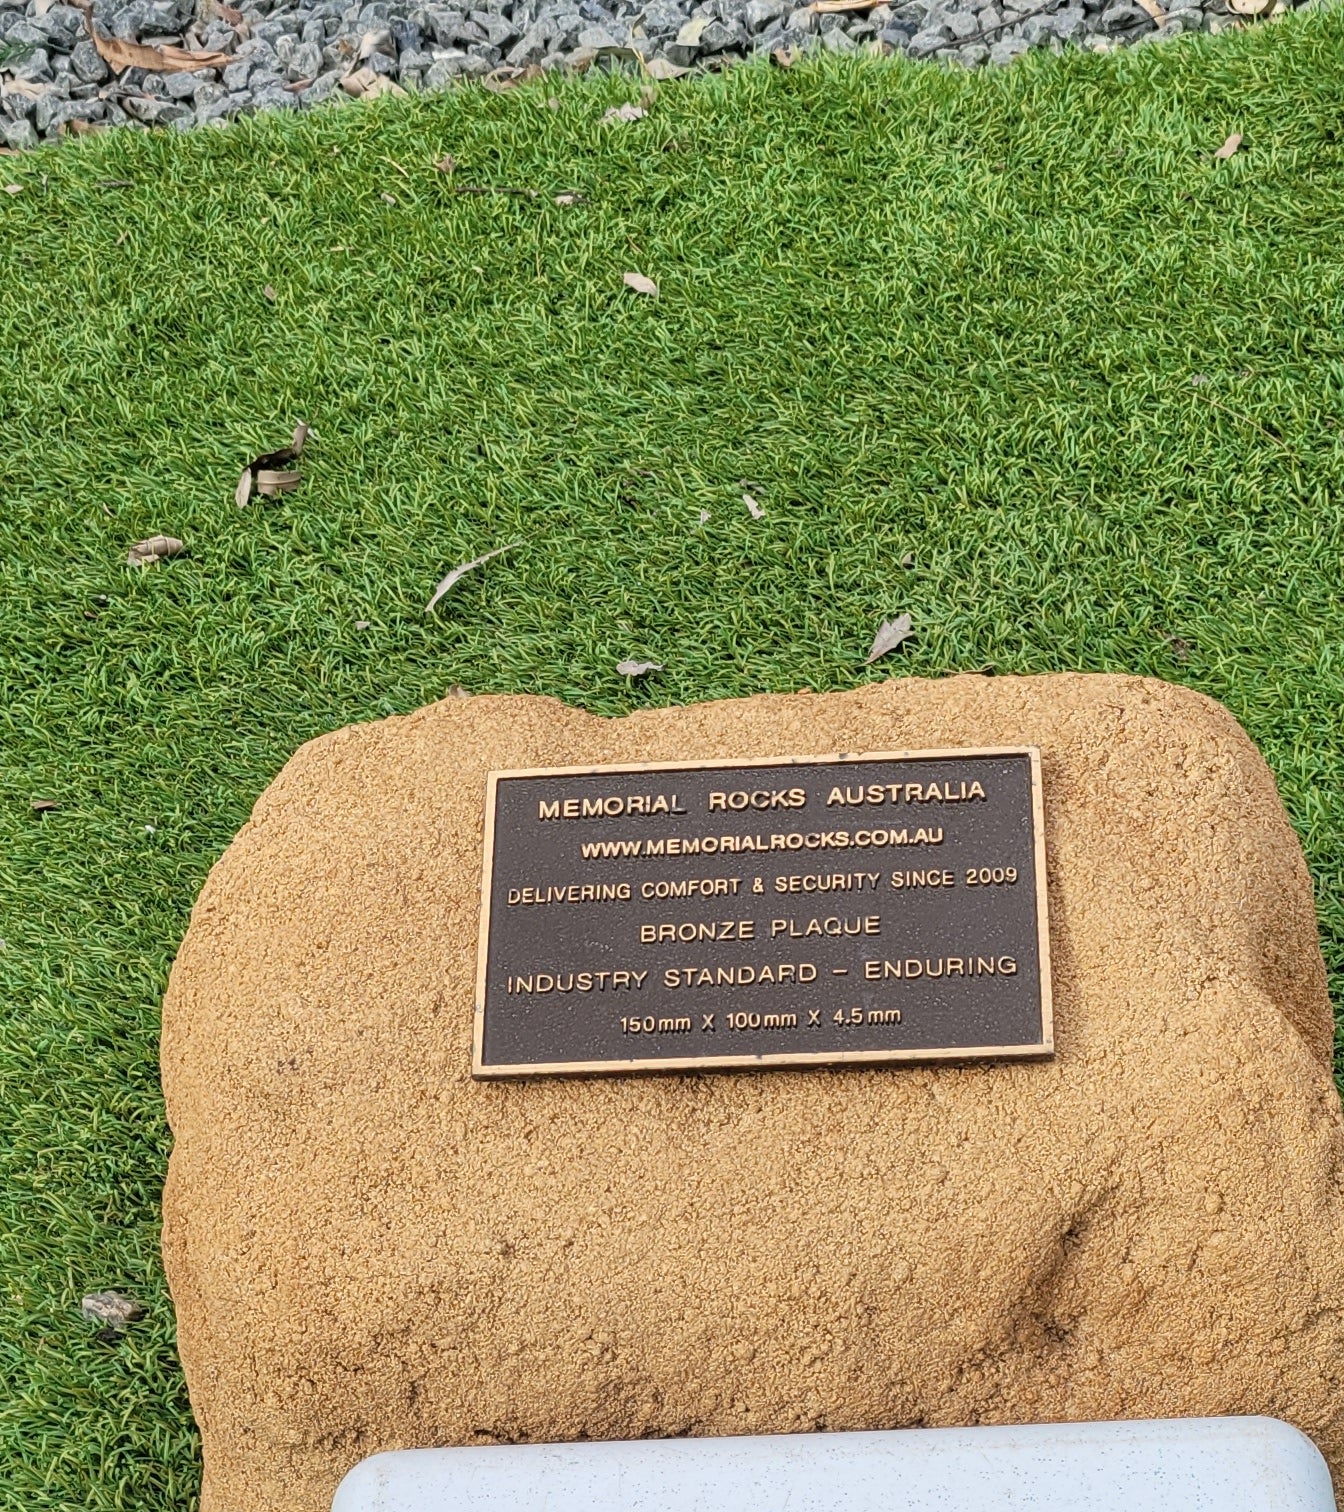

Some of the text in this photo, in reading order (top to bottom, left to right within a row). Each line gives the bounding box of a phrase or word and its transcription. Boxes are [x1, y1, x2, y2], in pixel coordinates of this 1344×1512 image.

[538, 781, 987, 821] MEMORIAL ROCKS AUSTRALIA
[581, 828, 944, 860] WWW.MEMORIALROCKS.COM.AU
[507, 867, 1018, 905] DELIVERING COMFORT & SECURITY SINCE 2009
[640, 916, 881, 944] BRONZE PLAQUE
[507, 970, 648, 995] INDUSTRY
[664, 963, 818, 988] STANDARD
[864, 956, 1017, 980] ENDURING
